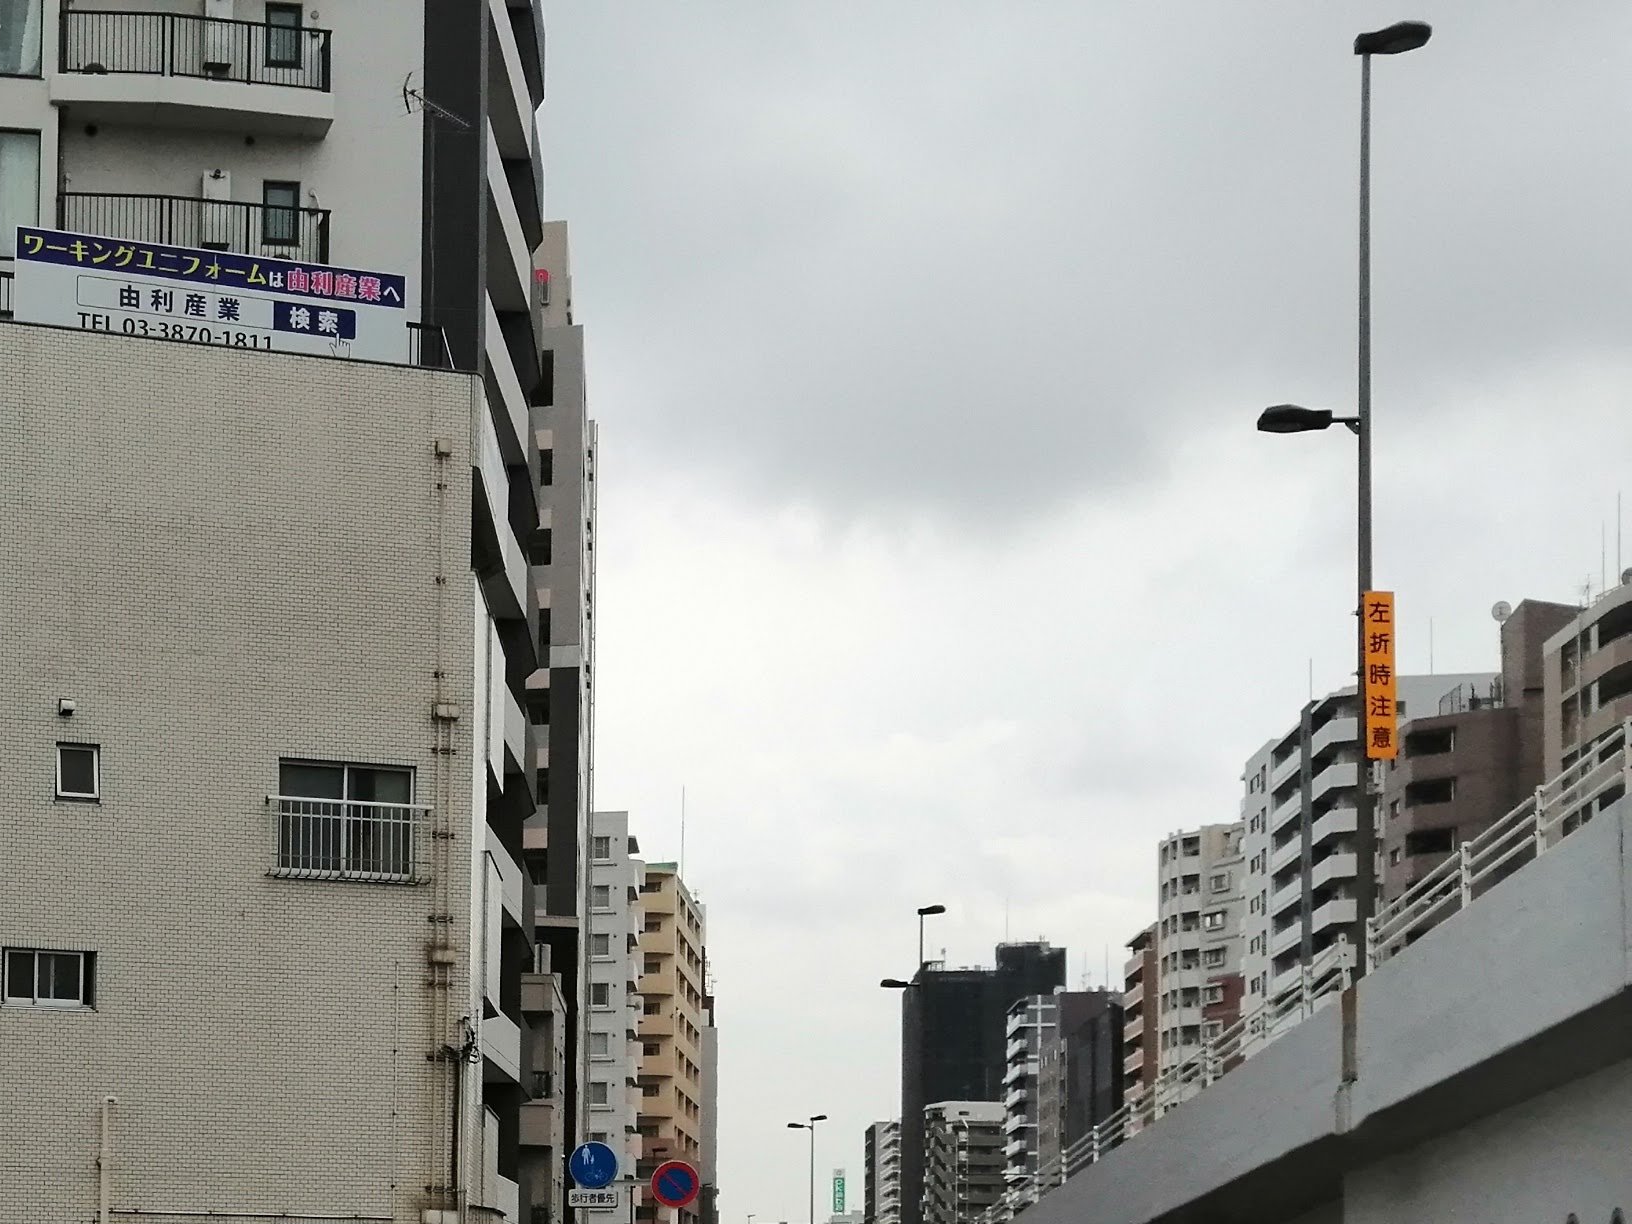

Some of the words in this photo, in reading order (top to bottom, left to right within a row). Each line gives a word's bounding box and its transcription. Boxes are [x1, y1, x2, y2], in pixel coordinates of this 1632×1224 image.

[23, 234, 402, 303] ワーキングユニフォームは由利産業へ
[77, 312, 112, 331] TEL
[122, 317, 273, 350] 03-3870-1811
[119, 284, 241, 322] 由利産業
[289, 306, 340, 335] 検索
[1369, 602, 1391, 748] 左折時注意
[571, 1192, 615, 1204] 歩行者優先
